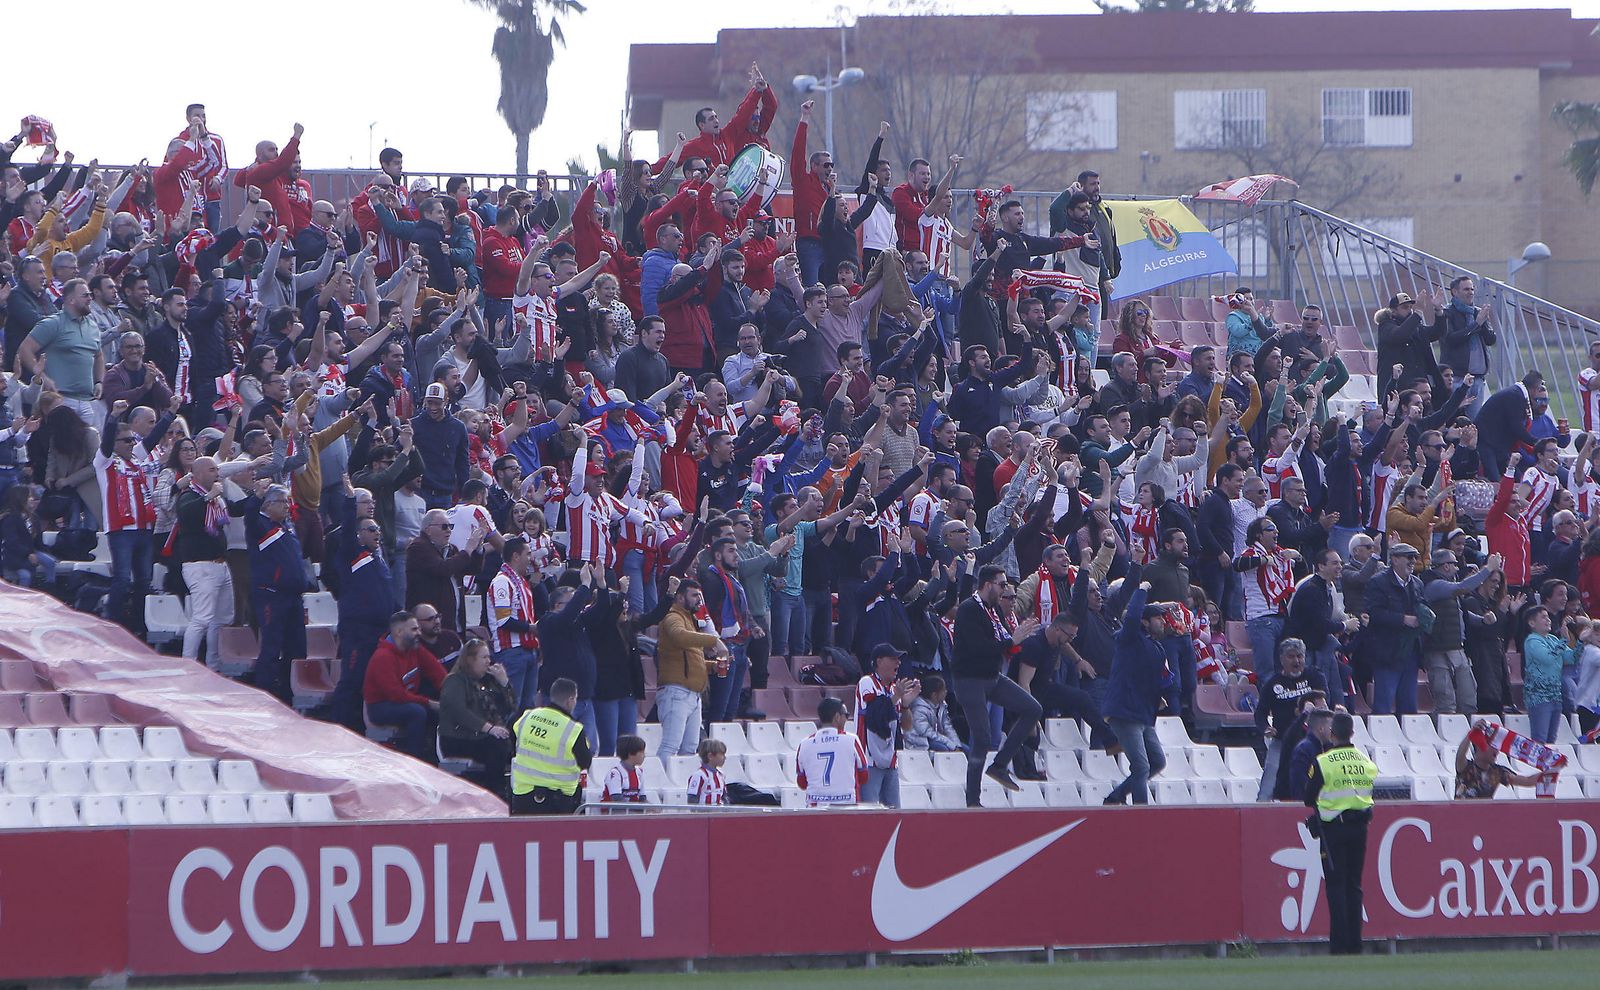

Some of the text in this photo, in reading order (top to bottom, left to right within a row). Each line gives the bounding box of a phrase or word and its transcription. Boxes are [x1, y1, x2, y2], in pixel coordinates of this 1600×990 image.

[1143, 250, 1208, 273] ALGECIRAS
[530, 715, 559, 727] SEGURIDAD
[530, 725, 547, 739] 782
[1328, 751, 1369, 763] SEGURID
[817, 751, 835, 786] 7
[1342, 764, 1365, 775] 1230
[1377, 816, 1600, 919] CaixaB
[168, 839, 671, 954] CORDIALITY
